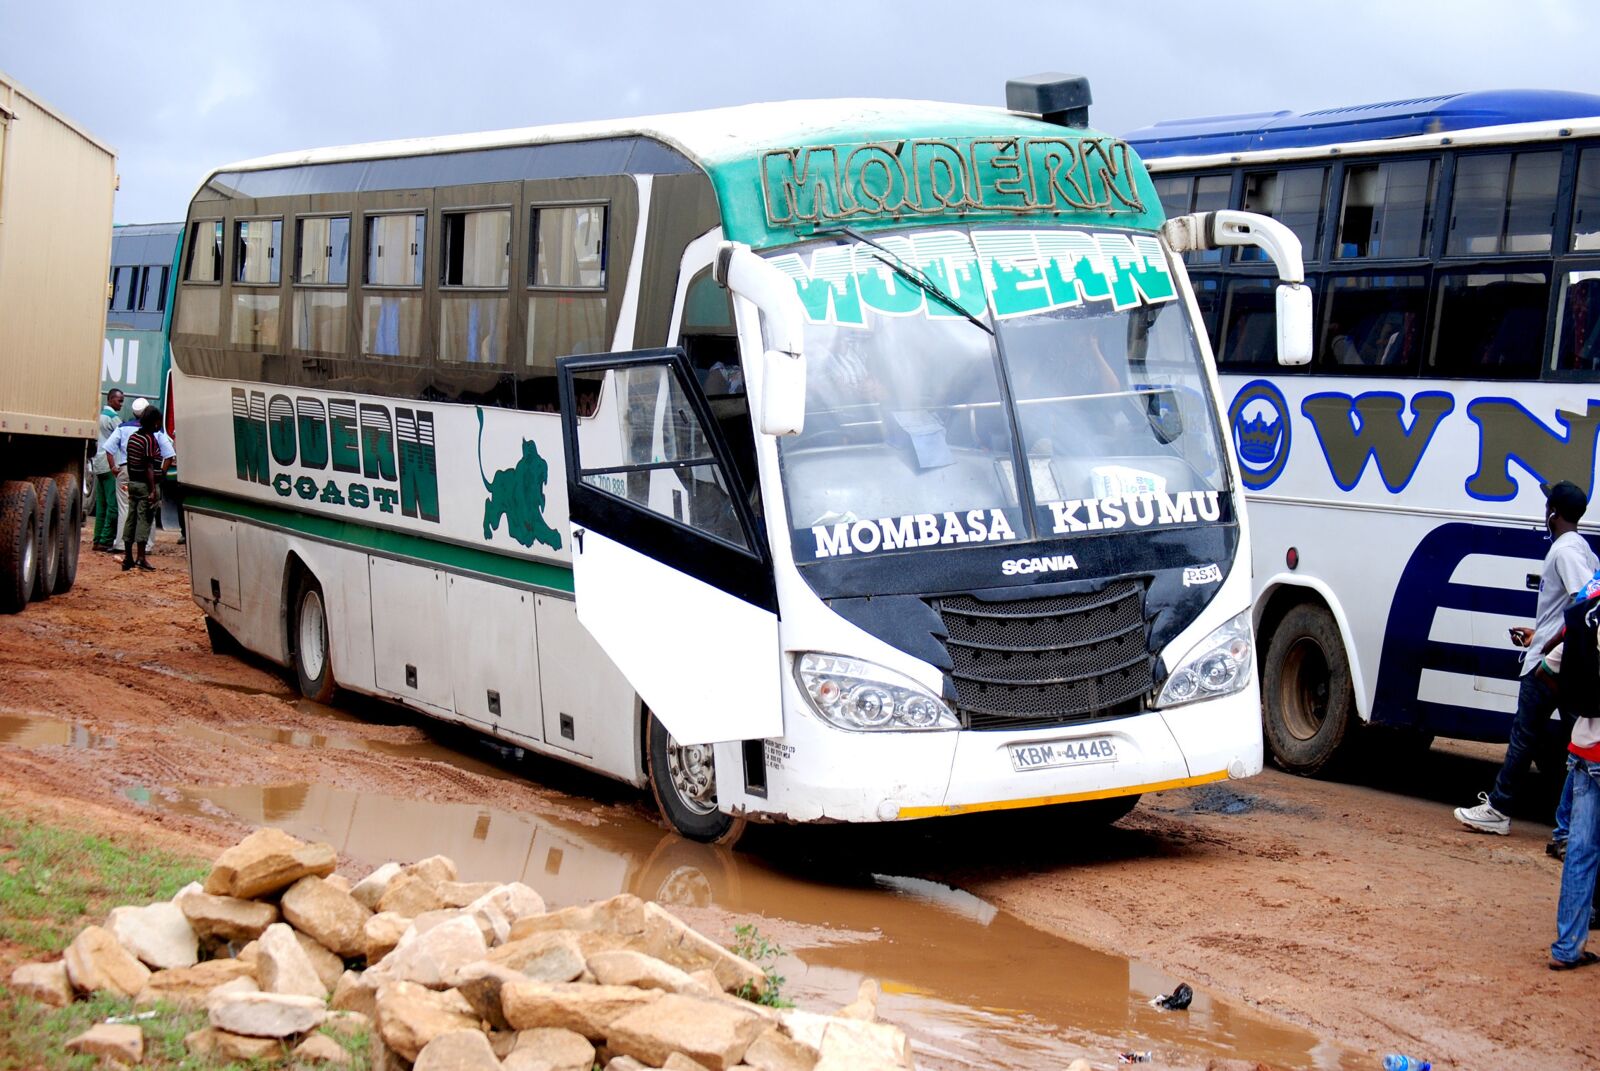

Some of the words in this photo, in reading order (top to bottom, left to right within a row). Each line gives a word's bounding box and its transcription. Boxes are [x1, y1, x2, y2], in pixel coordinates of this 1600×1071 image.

[762, 138, 1147, 223] MODERN
[765, 230, 1179, 329] MODERN
[231, 387, 440, 524] MODERN
[272, 472, 399, 514] COAST
[812, 508, 1016, 559] MOMBASA
[1047, 489, 1222, 535] KISUMU
[1002, 554, 1079, 576] SCANIA
[1015, 745, 1056, 767] KBM
[1065, 740, 1114, 760] 444B
